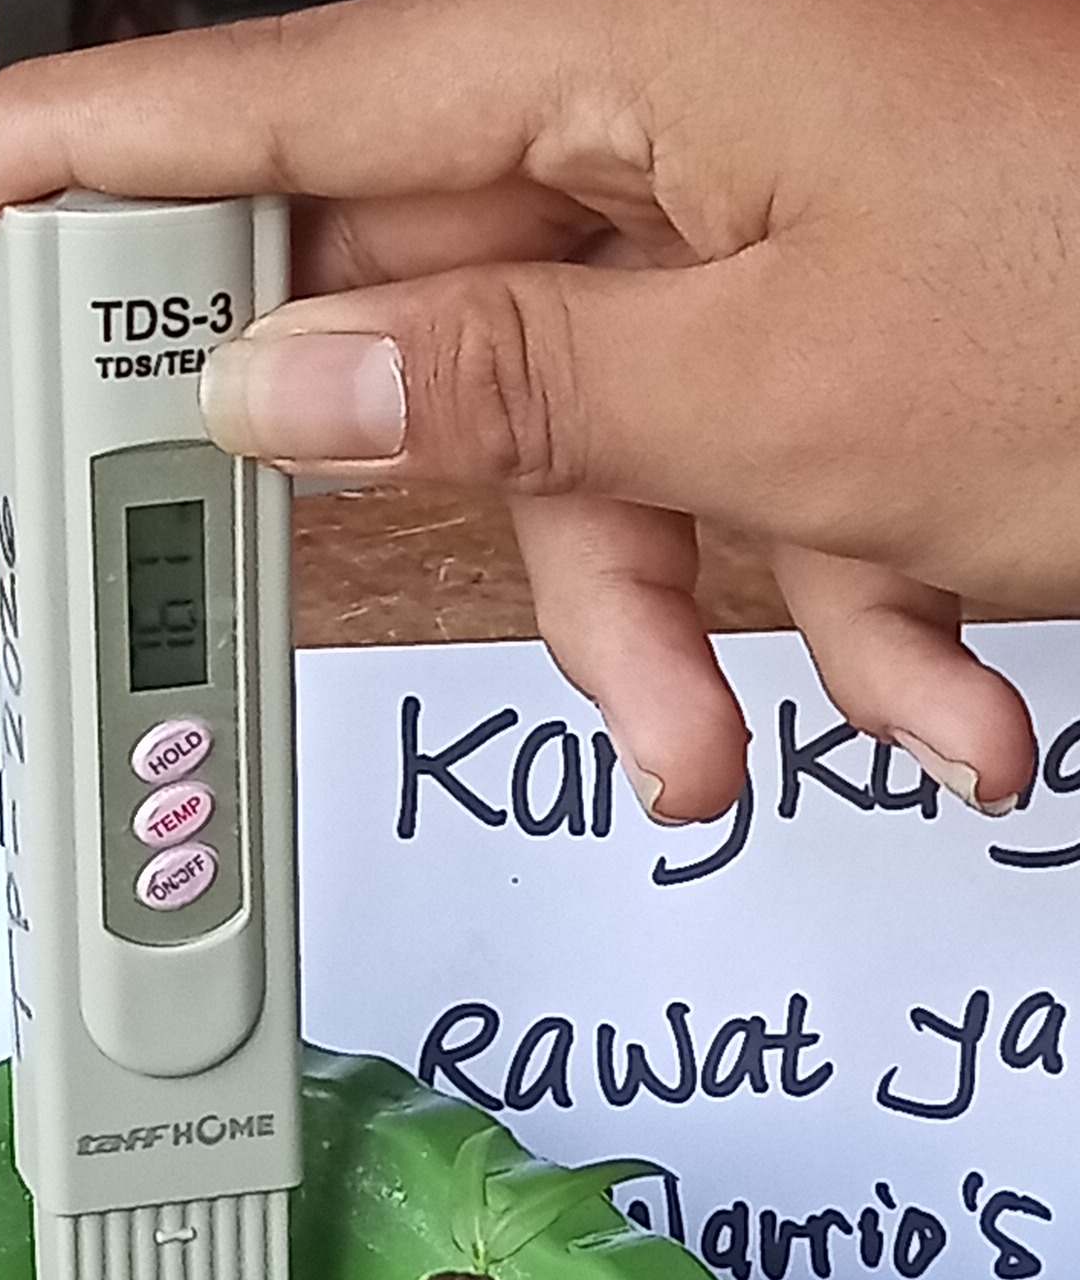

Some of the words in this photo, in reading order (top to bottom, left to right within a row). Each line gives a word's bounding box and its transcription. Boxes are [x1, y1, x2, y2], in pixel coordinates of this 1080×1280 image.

[91, 292, 233, 342] TDS-3
[148, 731, 202, 776] HOLD
[147, 796, 201, 838] TEMP
[419, 995, 833, 1112] Rawat
[876, 989, 1067, 1121] ya
